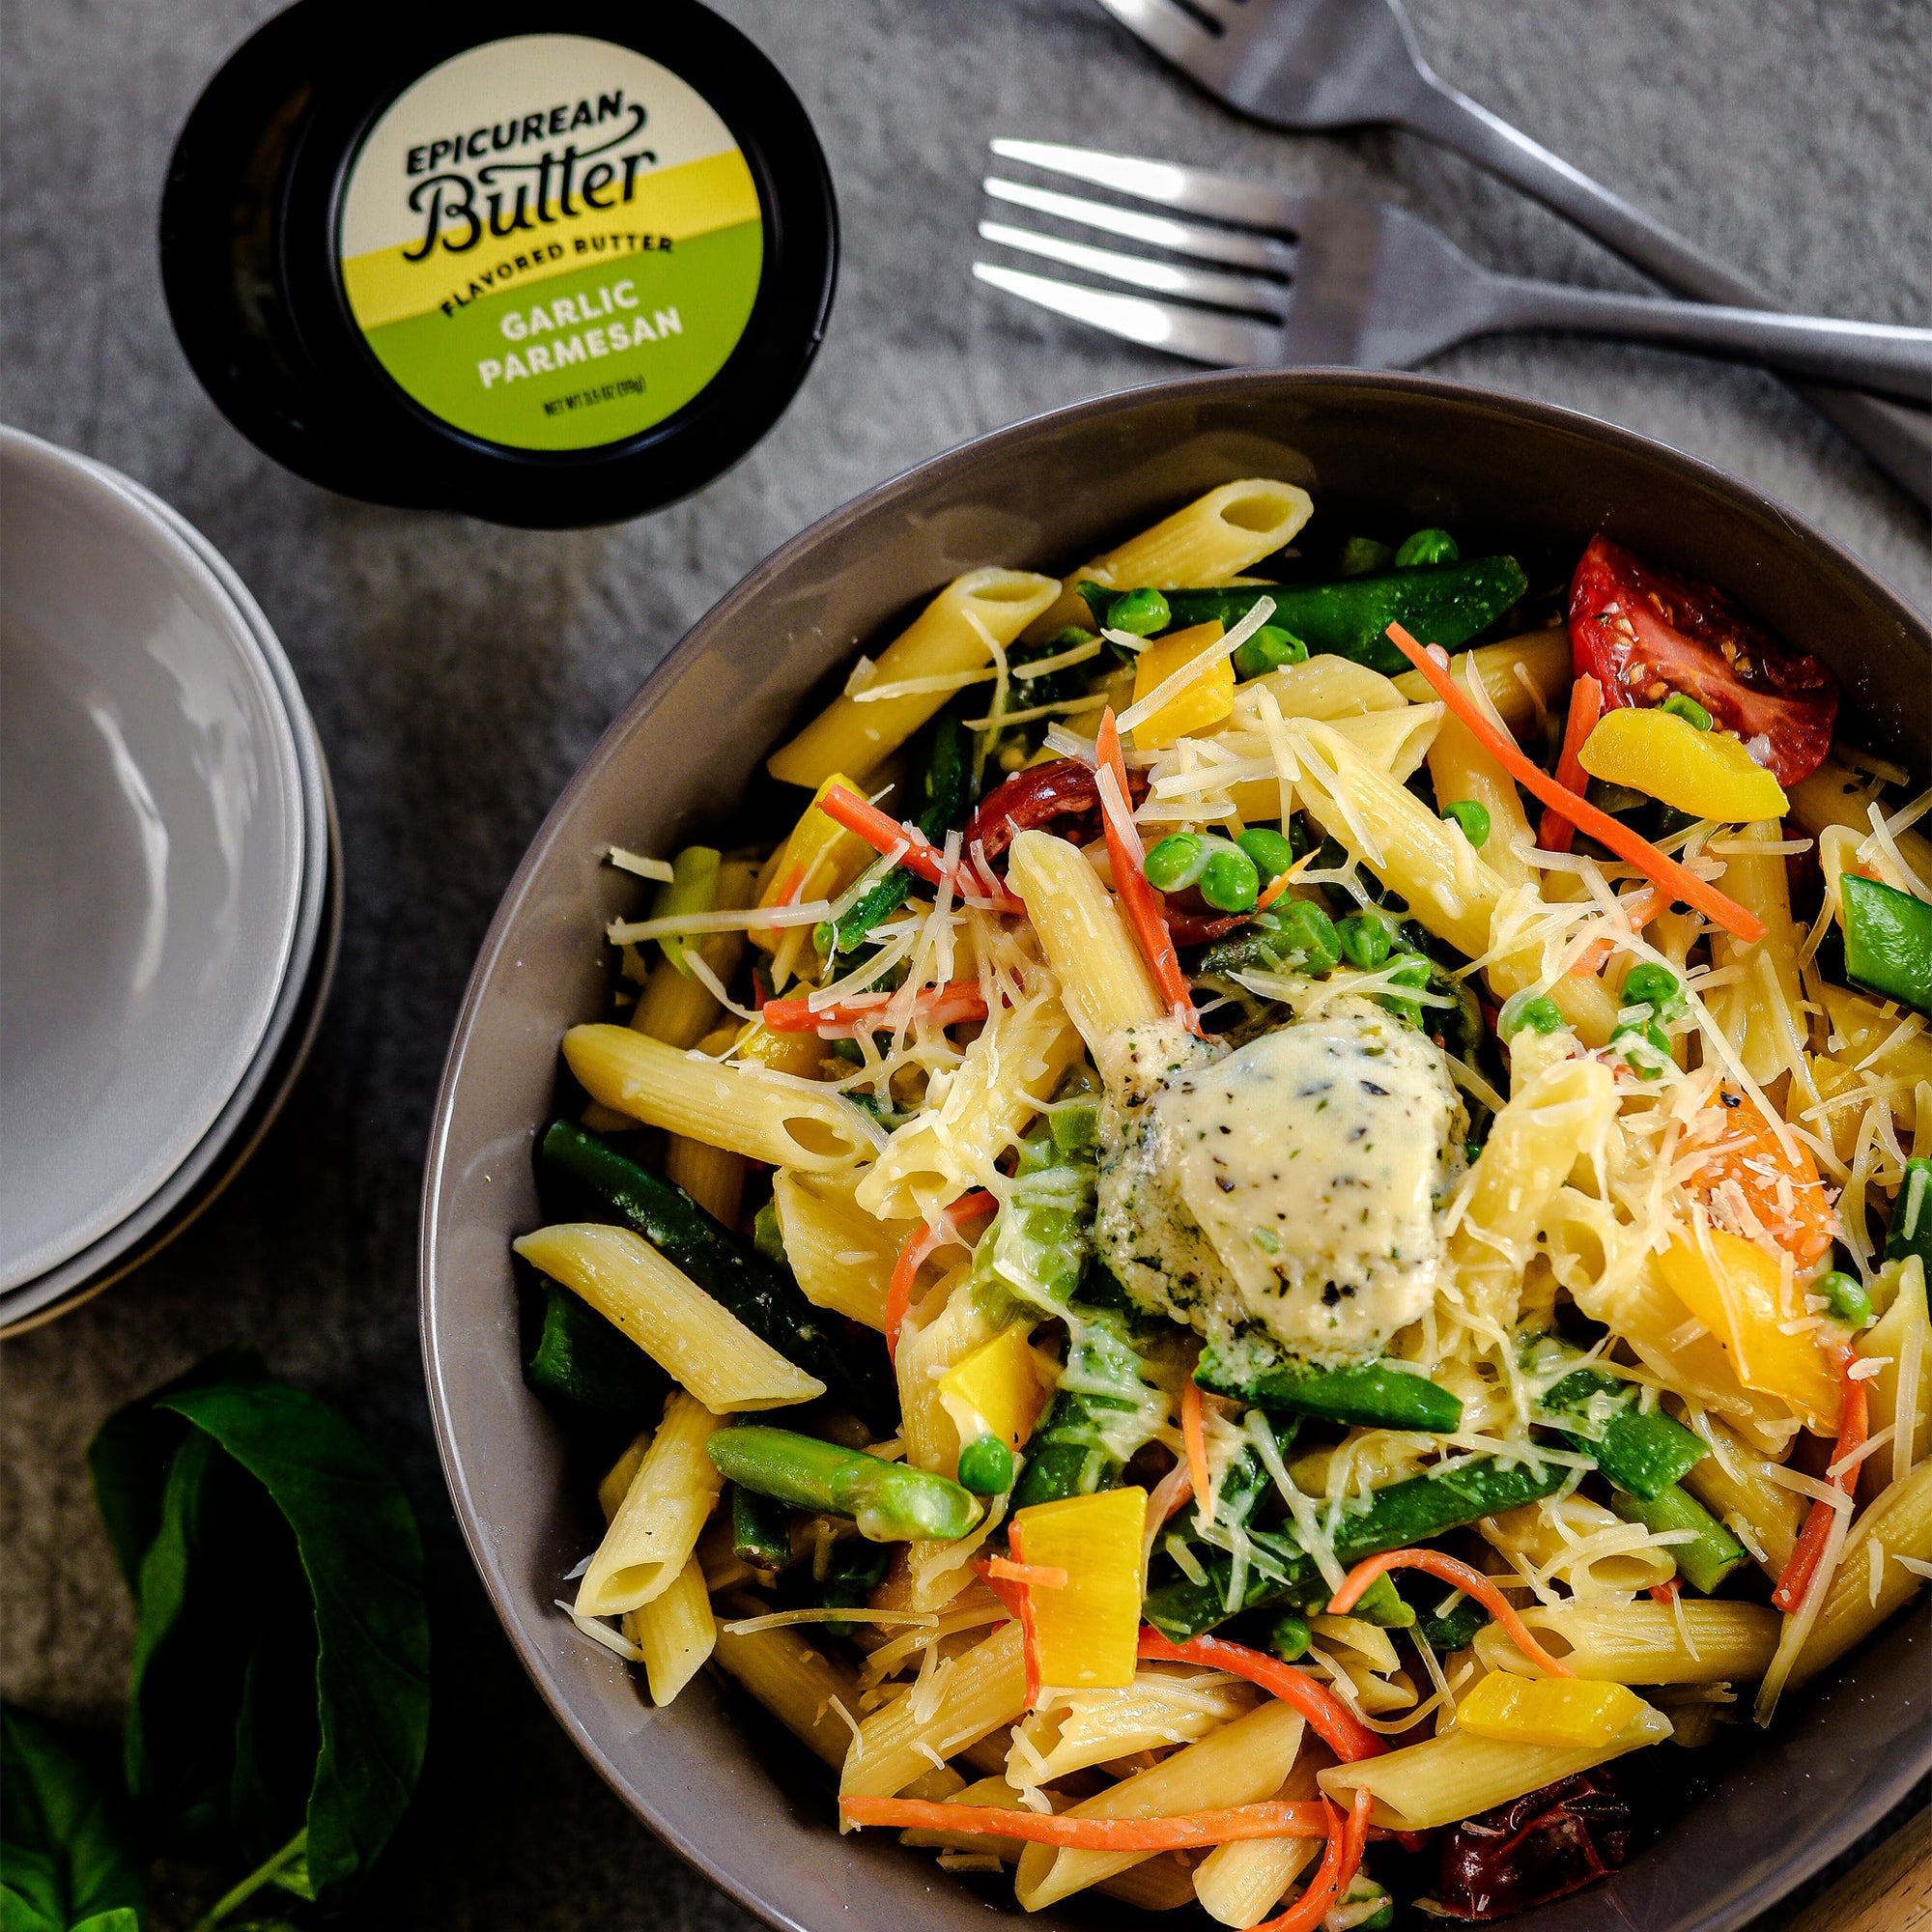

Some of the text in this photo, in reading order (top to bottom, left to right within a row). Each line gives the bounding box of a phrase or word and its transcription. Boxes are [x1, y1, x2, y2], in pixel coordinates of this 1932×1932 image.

[406, 89, 623, 176] EPICUREAN
[402, 103, 656, 262] Butter
[441, 235, 673, 318] FLAVORED BUTTER
[500, 278, 639, 342] GARLIC
[477, 305, 683, 389] PARMESAN
[544, 398, 564, 415] NET
